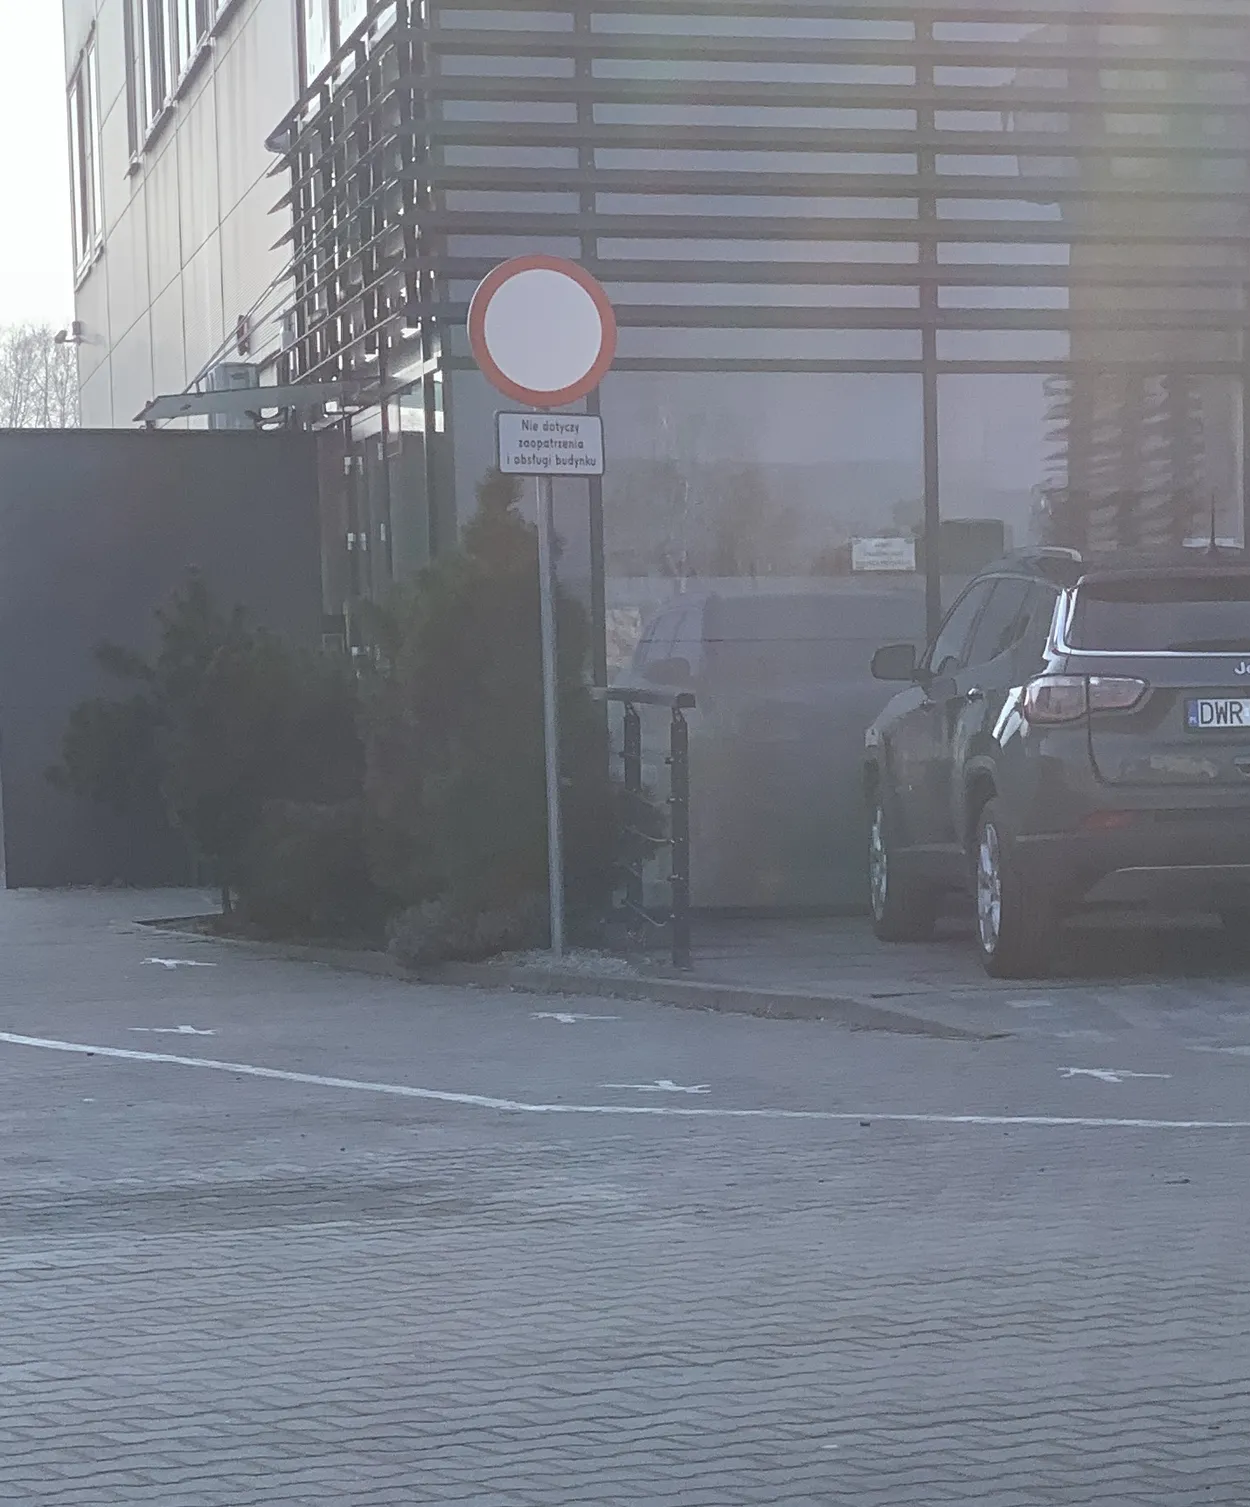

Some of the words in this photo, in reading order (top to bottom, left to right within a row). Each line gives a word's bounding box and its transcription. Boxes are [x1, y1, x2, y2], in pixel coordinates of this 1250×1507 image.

[521, 419, 539, 432] Nie
[542, 420, 580, 434] dotyczy
[518, 438, 584, 451] zaopatrzenia
[513, 454, 552, 468] obsługi
[555, 454, 596, 468] budynku
[1200, 701, 1243, 725] DWR
